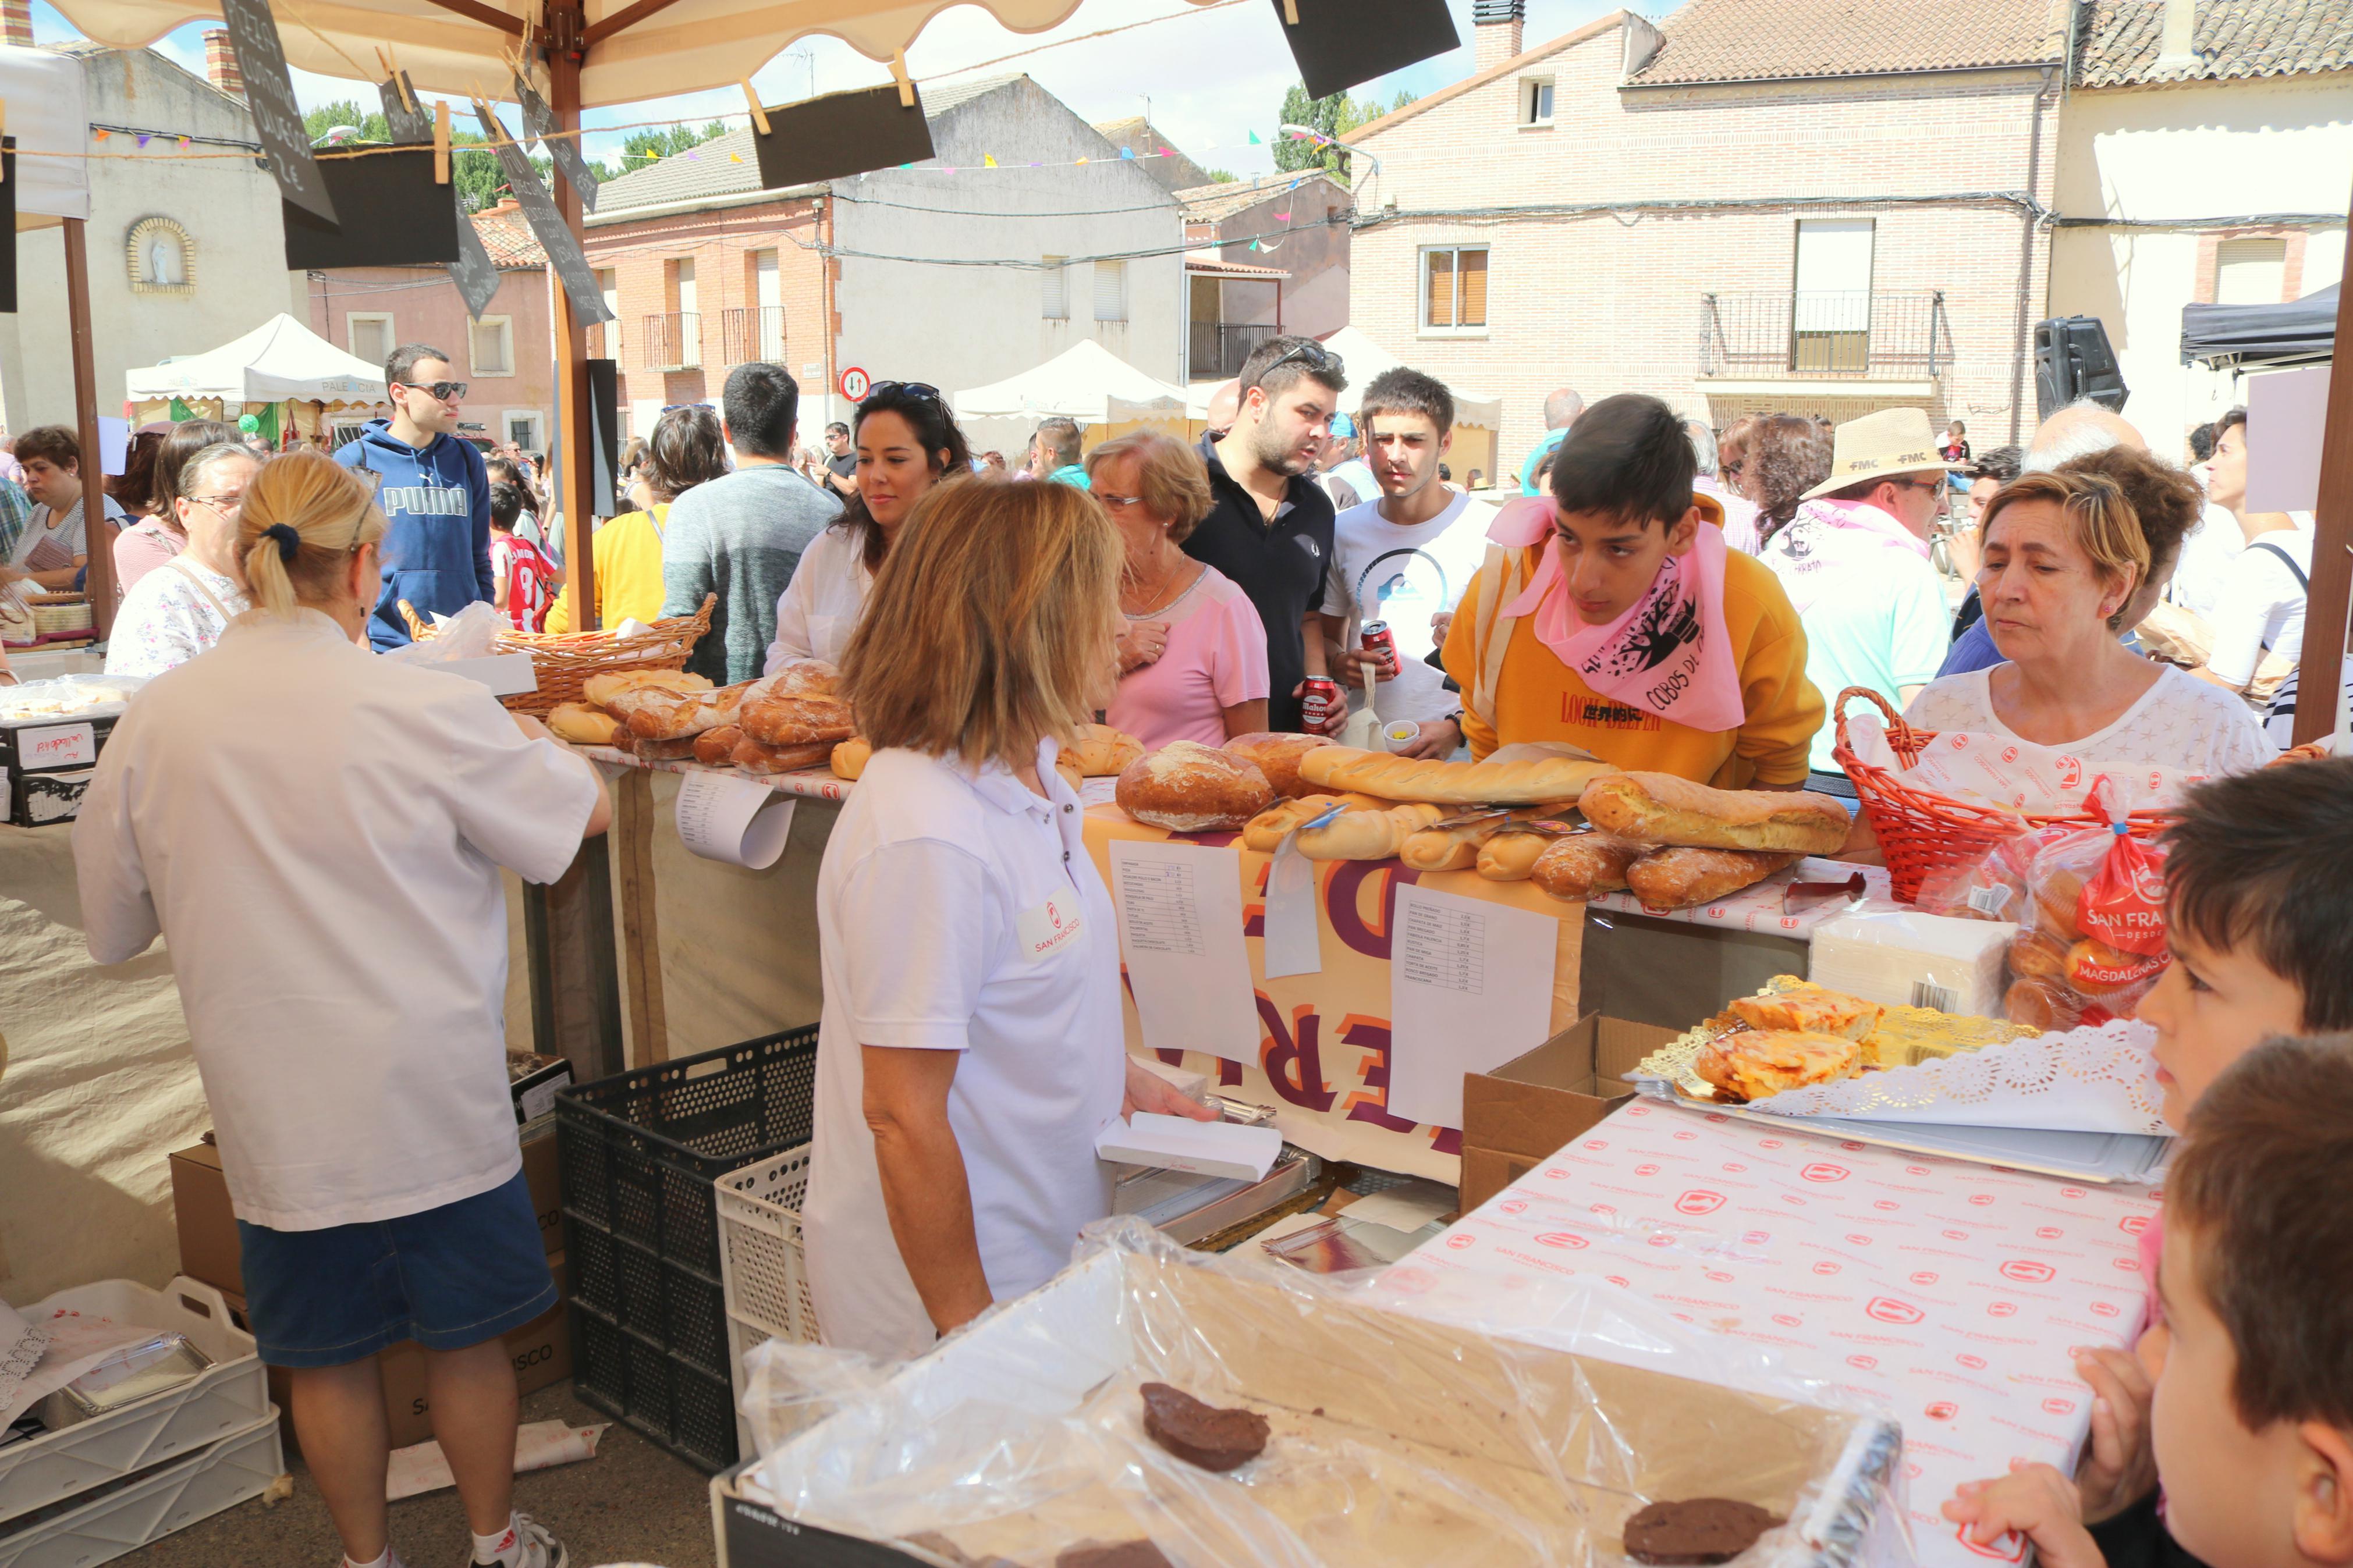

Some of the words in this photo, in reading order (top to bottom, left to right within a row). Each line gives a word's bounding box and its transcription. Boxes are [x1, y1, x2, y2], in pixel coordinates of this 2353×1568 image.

[322, 381, 377, 394] PALENCIA
[383, 486, 468, 517] PUMA
[1646, 669, 1689, 711] COBOS
[1303, 702, 1327, 712] Maho
[1582, 703, 1643, 723] 世界的に
[2087, 909, 2122, 927] SAN
[1035, 938, 1053, 952] SAN
[1053, 918, 1080, 944] FRANCISCO
[2126, 930, 2163, 939] DESDE
[2079, 958, 2159, 982] MAGDALENAS
[1517, 1250, 1575, 1276] FRANCISCO
[1788, 1289, 1854, 1302] FRANCISCO
[1992, 1284, 2061, 1302] FRANCISCO
[1676, 1297, 1740, 1310] FRANCISCO
[1857, 1332, 1925, 1348] FRANCISCO
[1965, 1330, 2038, 1346] FRANCISCO
[1935, 1370, 2010, 1398] FRANCISCO
